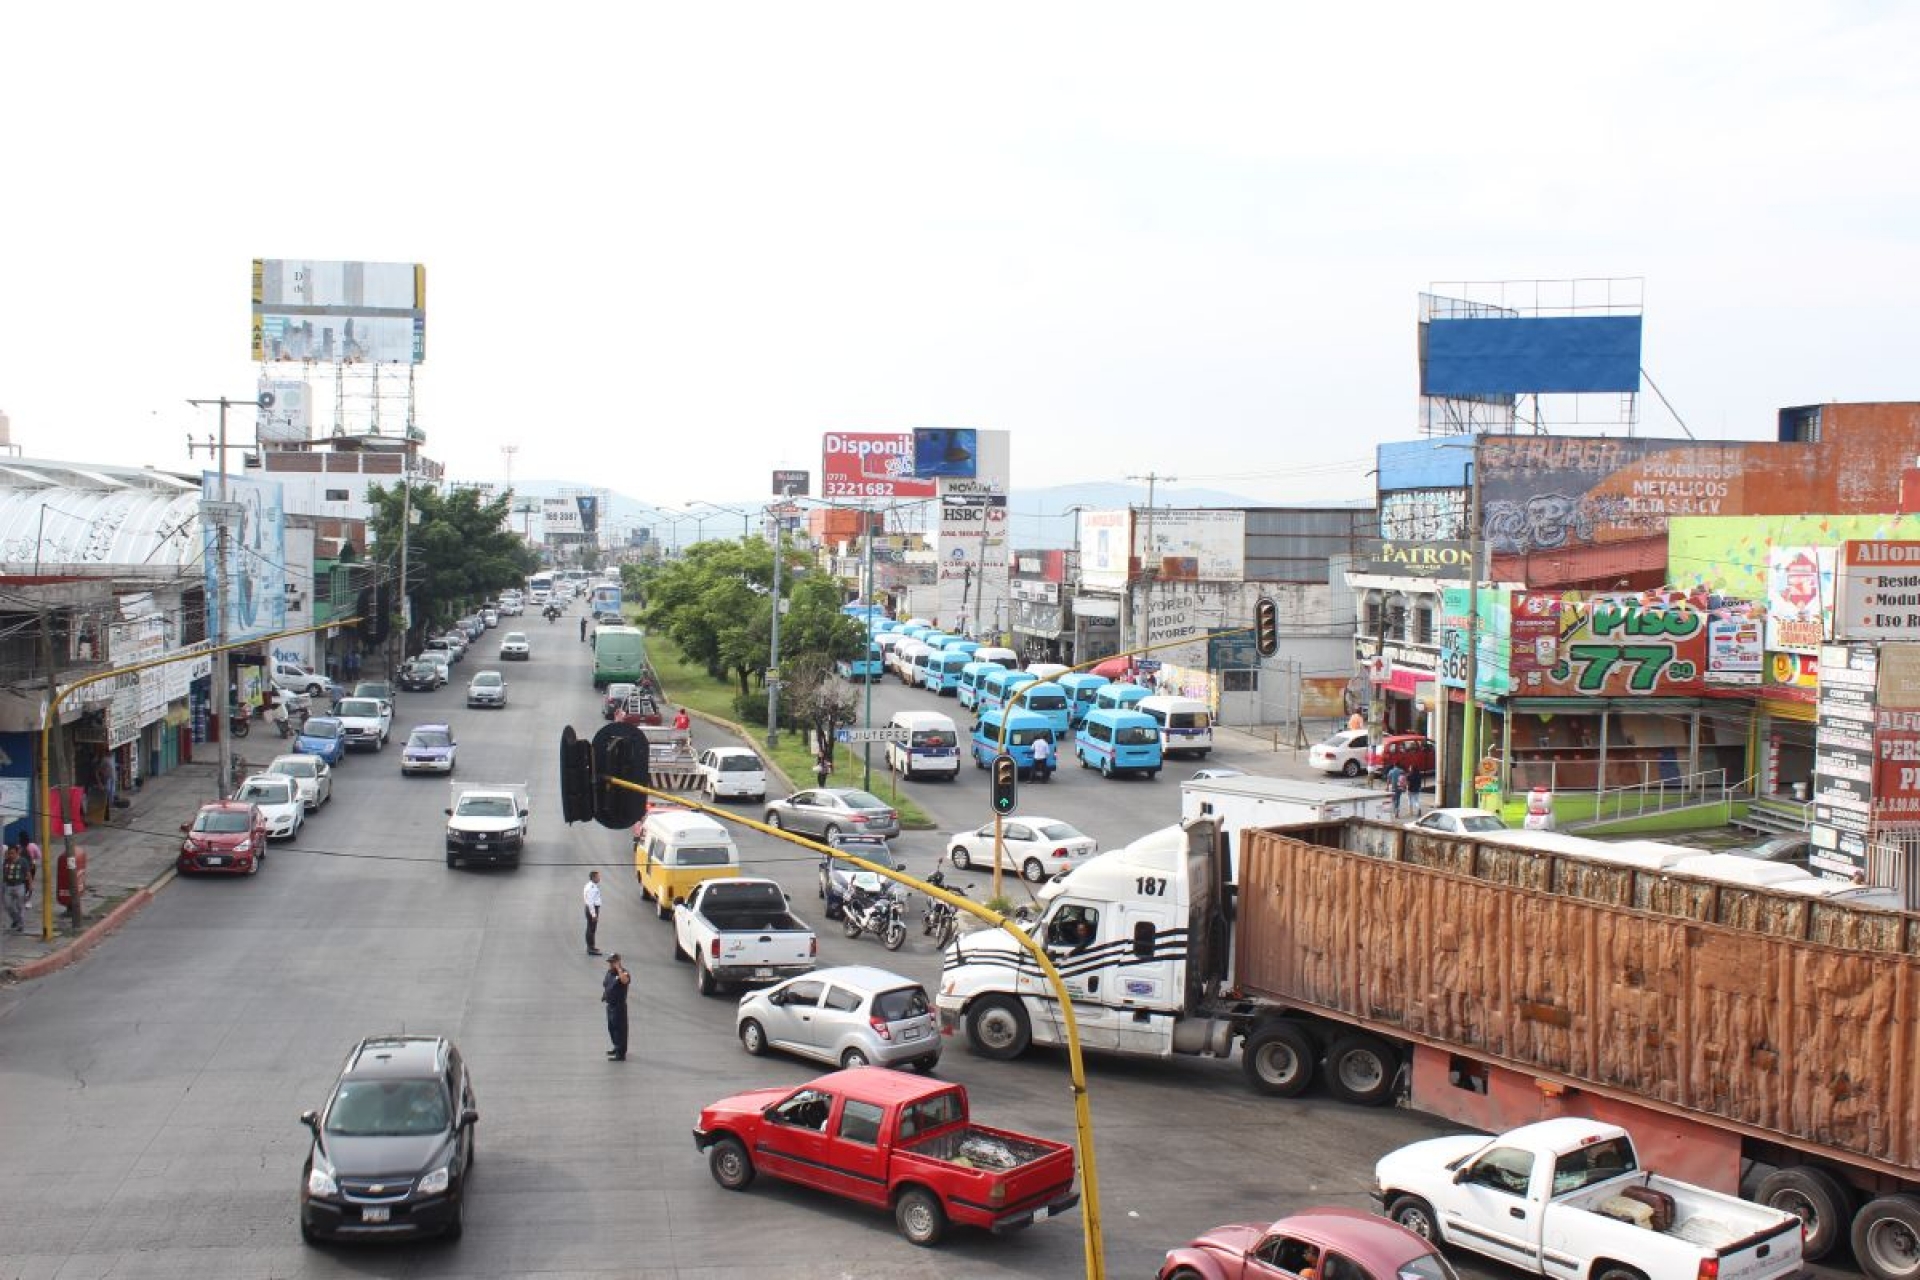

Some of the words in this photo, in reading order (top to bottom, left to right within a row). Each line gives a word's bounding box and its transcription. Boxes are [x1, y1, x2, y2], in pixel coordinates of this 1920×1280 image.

[827, 482, 894, 495] 3221682
[943, 508, 983, 520] HSBC
[1876, 613, 1901, 627] Uso
[852, 730, 908, 740] JIUTEPEC
[1136, 876, 1167, 897] 187
